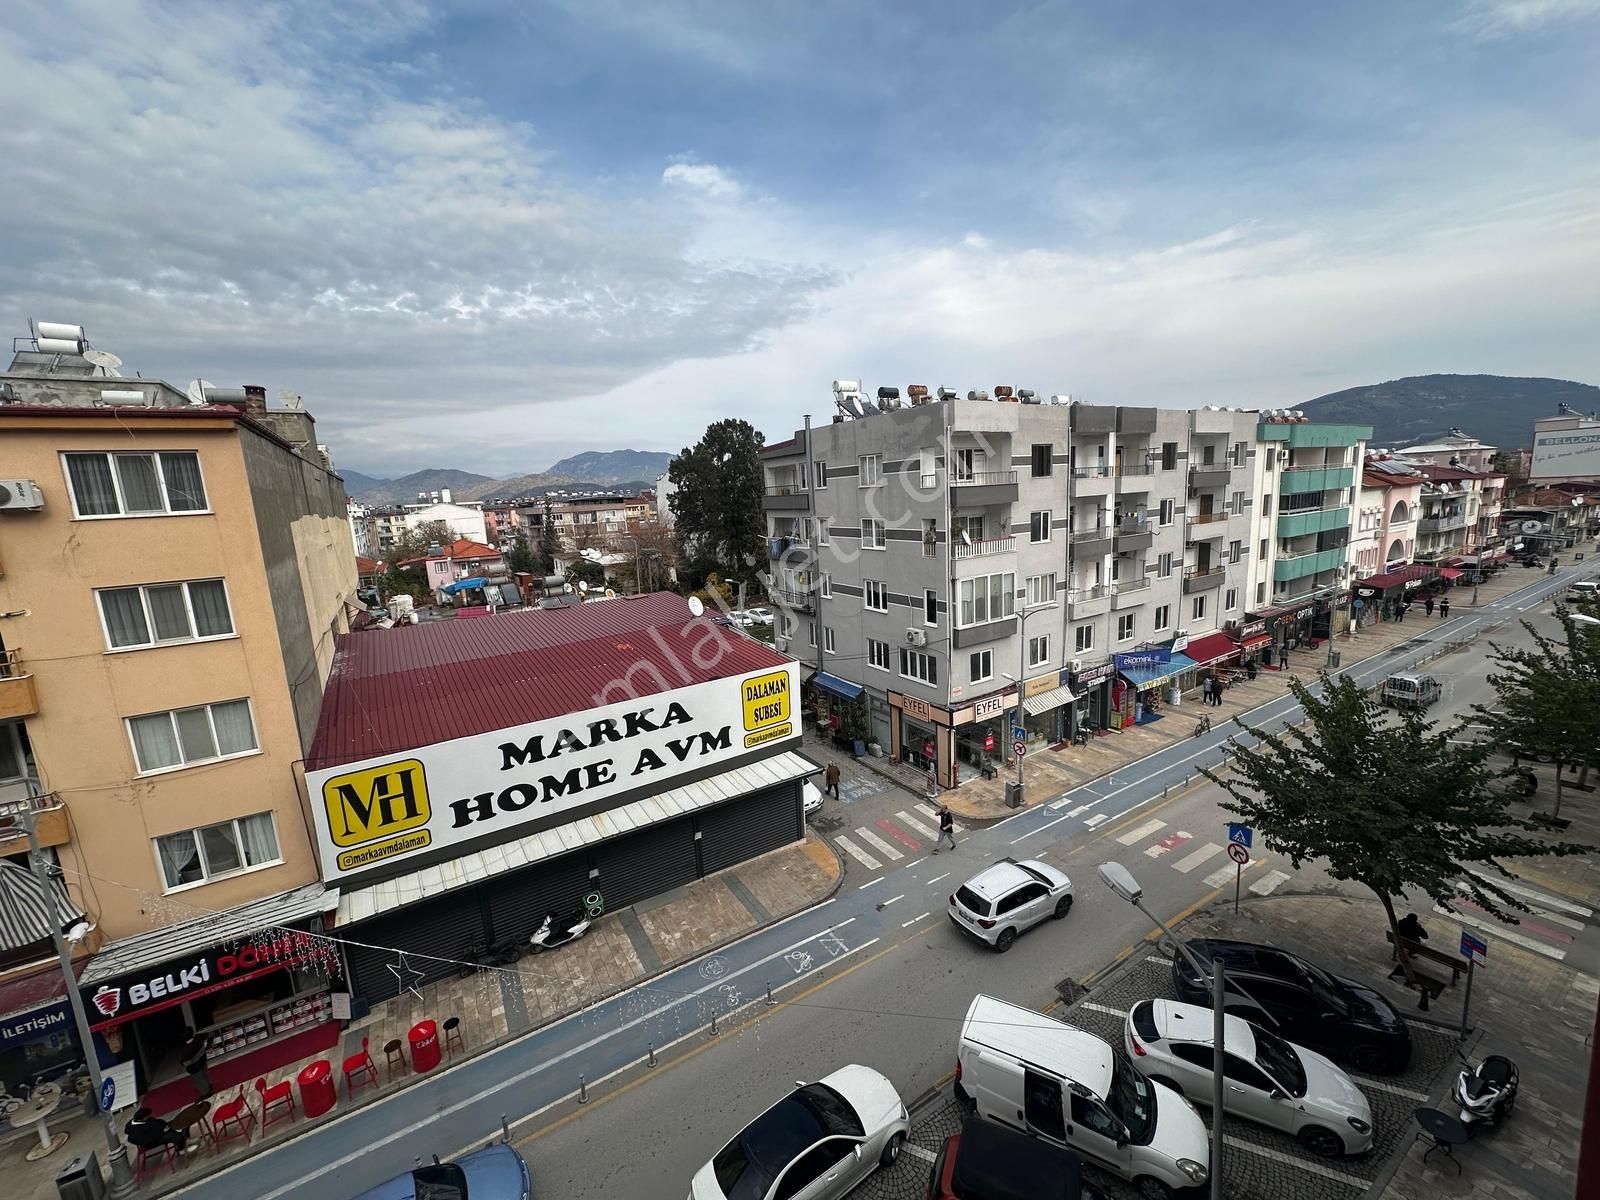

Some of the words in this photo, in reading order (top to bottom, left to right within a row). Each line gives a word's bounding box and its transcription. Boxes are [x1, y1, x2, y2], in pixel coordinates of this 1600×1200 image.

[1545, 436, 1600, 445] BELLON
[1123, 654, 1152, 666] ekomini
[746, 678, 786, 701] DALAMAN
[754, 698, 782, 725] ŞUBESİ
[904, 697, 928, 715] EYFEL
[976, 697, 1003, 716] EYFEL
[499, 702, 693, 770] MARKA
[449, 759, 616, 828] HOME
[631, 725, 732, 776] AVM
[334, 768, 423, 836] MH
[128, 958, 211, 1006] BELKİ
[1, 1012, 66, 1040] İLETİŞİM
